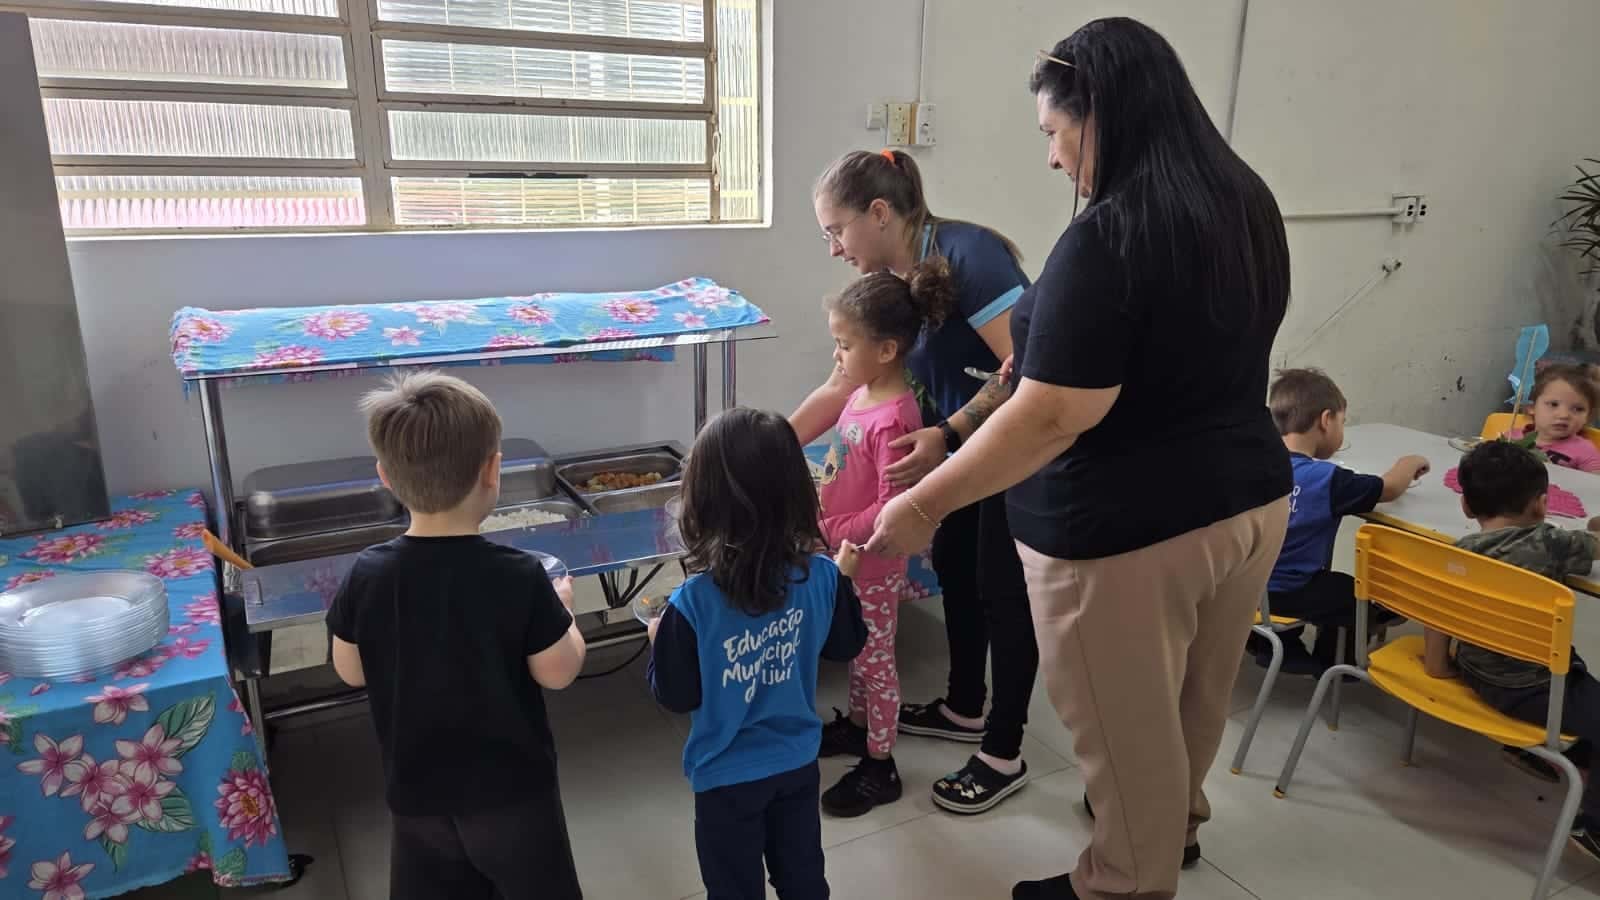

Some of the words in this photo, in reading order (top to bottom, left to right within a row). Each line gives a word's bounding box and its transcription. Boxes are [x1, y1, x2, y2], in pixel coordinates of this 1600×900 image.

[722, 627, 800, 688] Municipl
[723, 608, 803, 662] Educação
[745, 677, 757, 703] d
